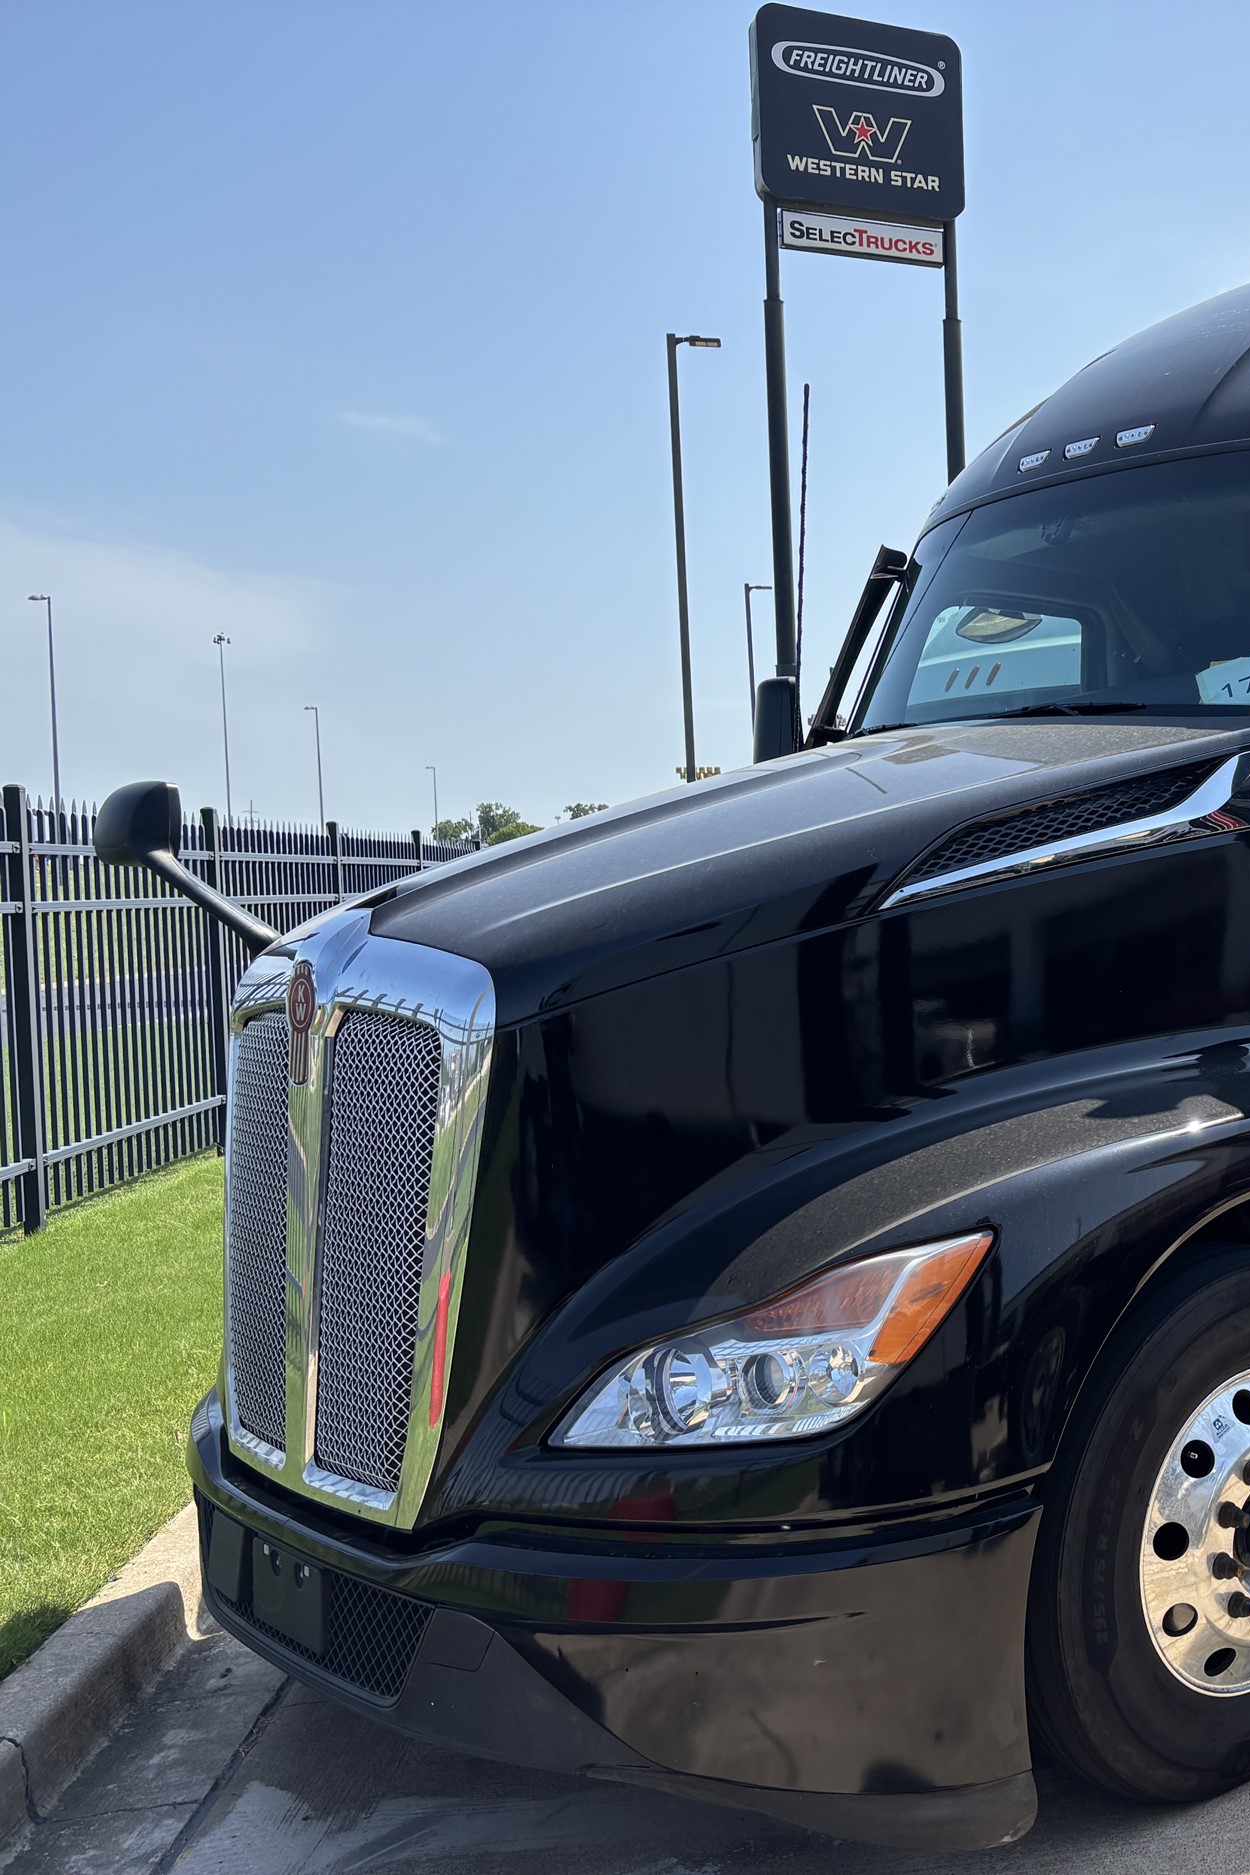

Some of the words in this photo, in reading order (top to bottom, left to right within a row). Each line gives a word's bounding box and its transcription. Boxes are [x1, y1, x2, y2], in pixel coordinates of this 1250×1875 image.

[789, 49, 928, 89] FREIGHTLINER
[787, 154, 884, 184] WESTERN
[890, 170, 940, 192] STAR
